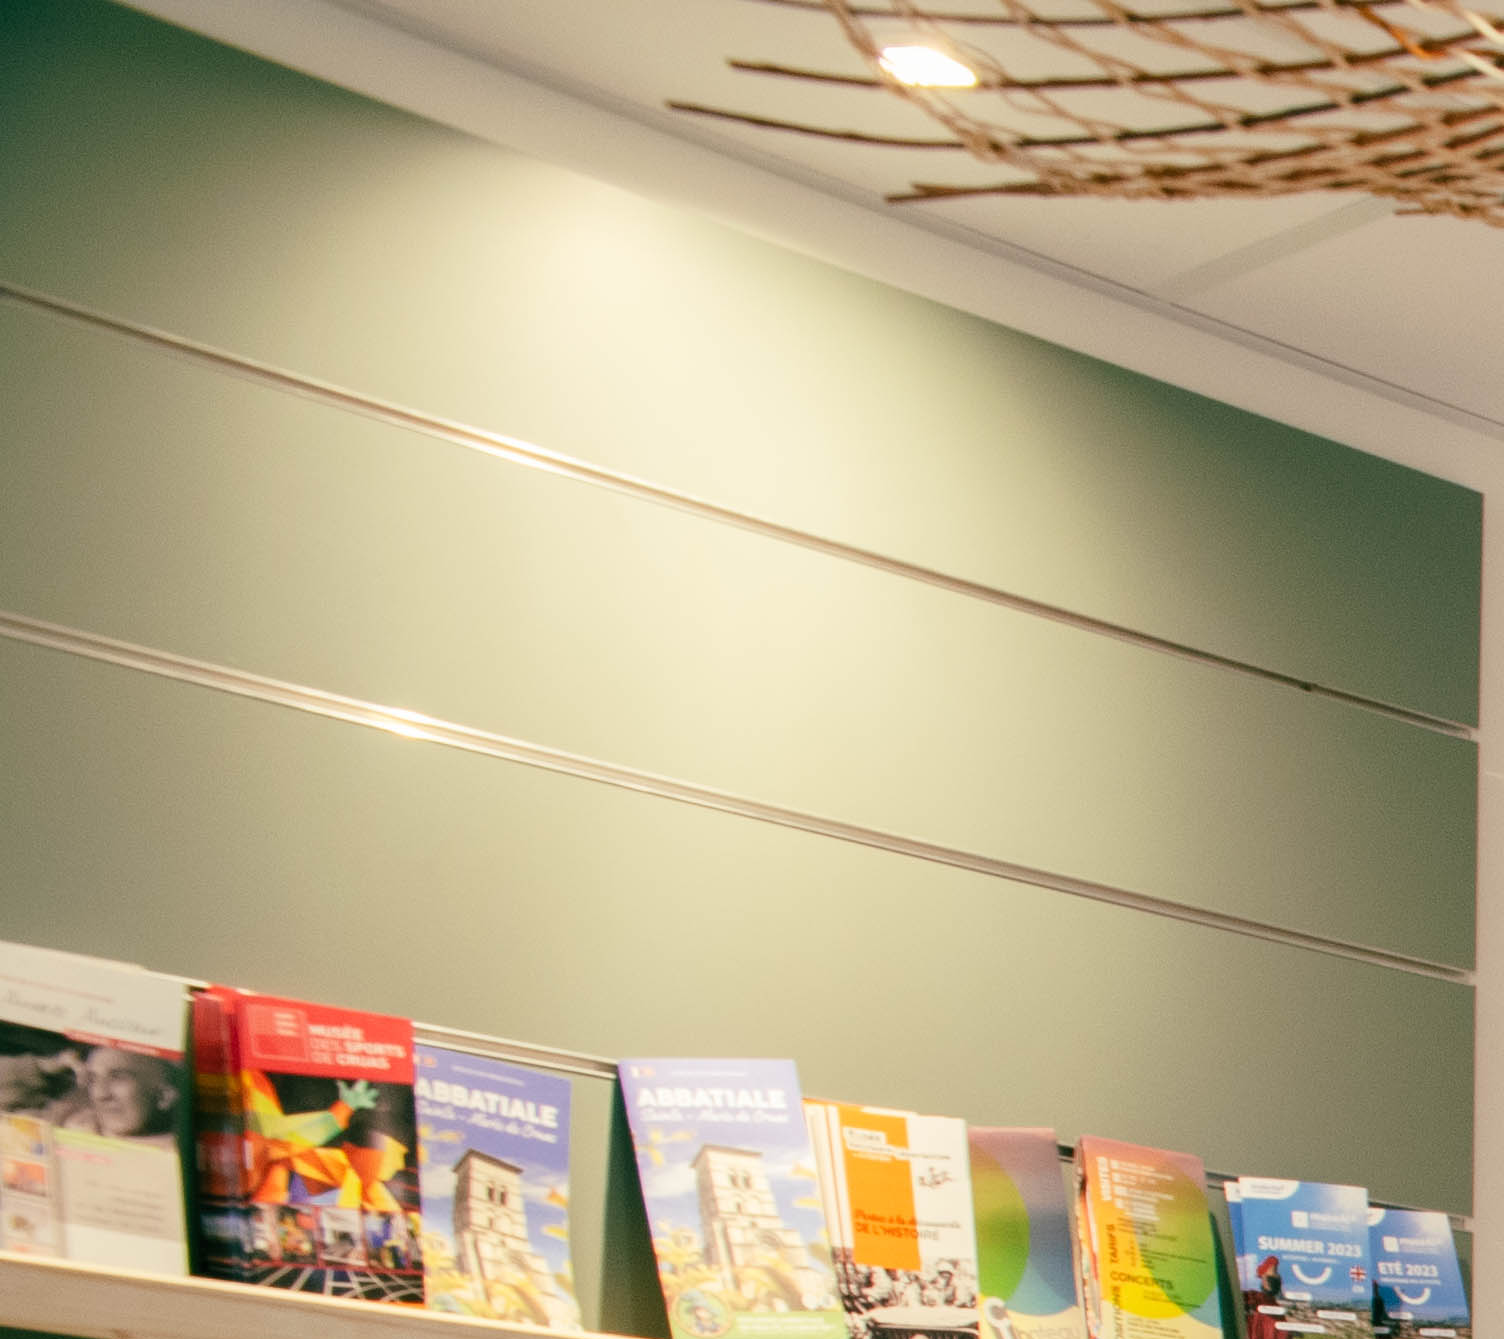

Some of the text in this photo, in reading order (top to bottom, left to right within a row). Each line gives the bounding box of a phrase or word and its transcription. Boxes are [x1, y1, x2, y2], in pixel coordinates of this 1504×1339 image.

[414, 1077, 559, 1129] ABBATIALE
[637, 1086, 789, 1110] ABBATIALE
[1257, 1235, 1362, 1258] SUMMER 2023
[1109, 1270, 1175, 1291] CONCERTS
[1405, 1261, 1439, 1279] 2023
